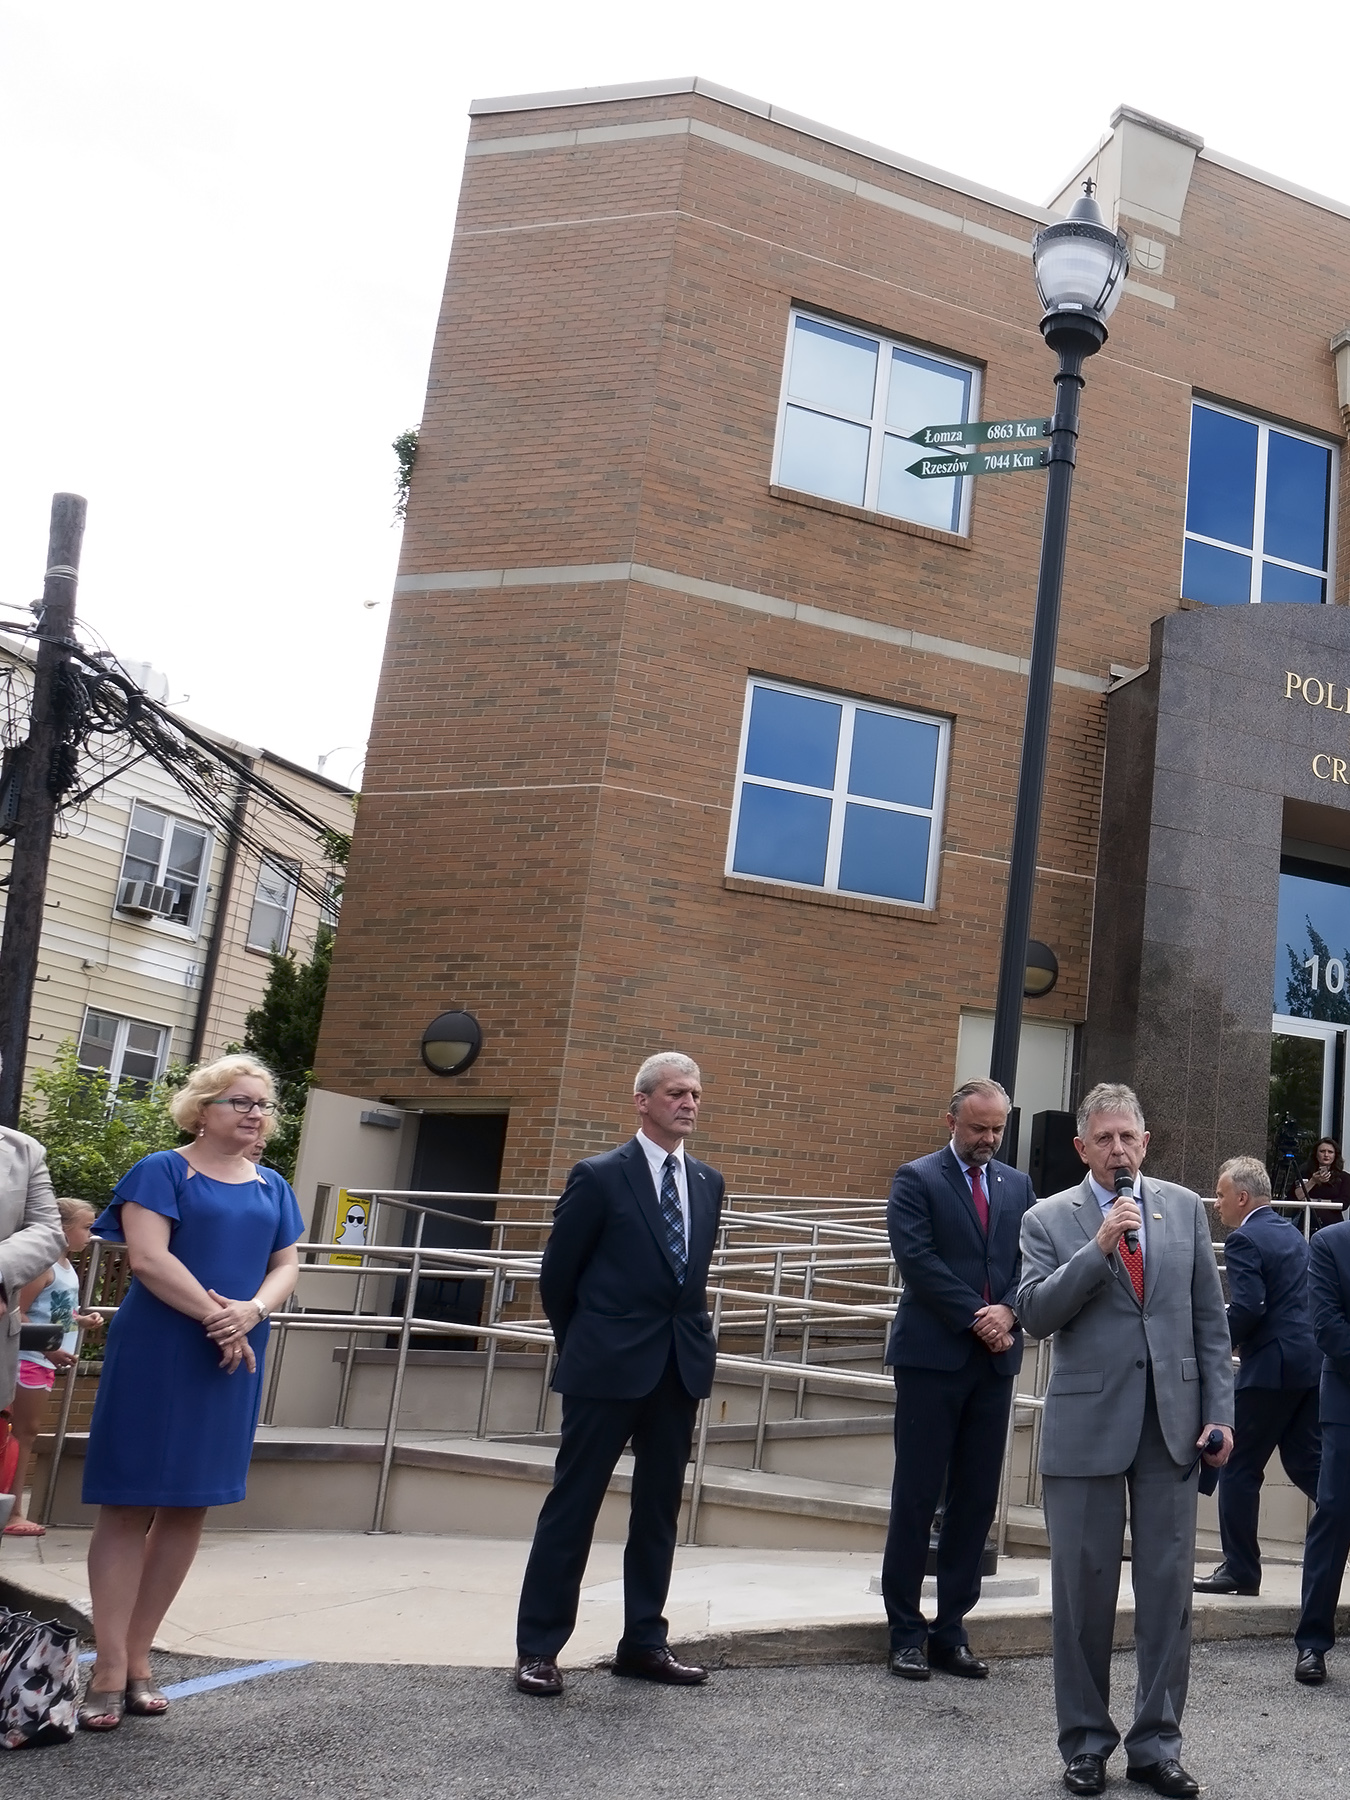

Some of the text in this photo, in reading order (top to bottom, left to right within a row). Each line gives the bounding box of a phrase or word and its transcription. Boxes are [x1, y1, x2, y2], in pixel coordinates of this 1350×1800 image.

[987, 424, 1013, 440] 6863
[1016, 423, 1037, 438] Km
[921, 454, 1034, 476] Rzeszów 7044 Km
